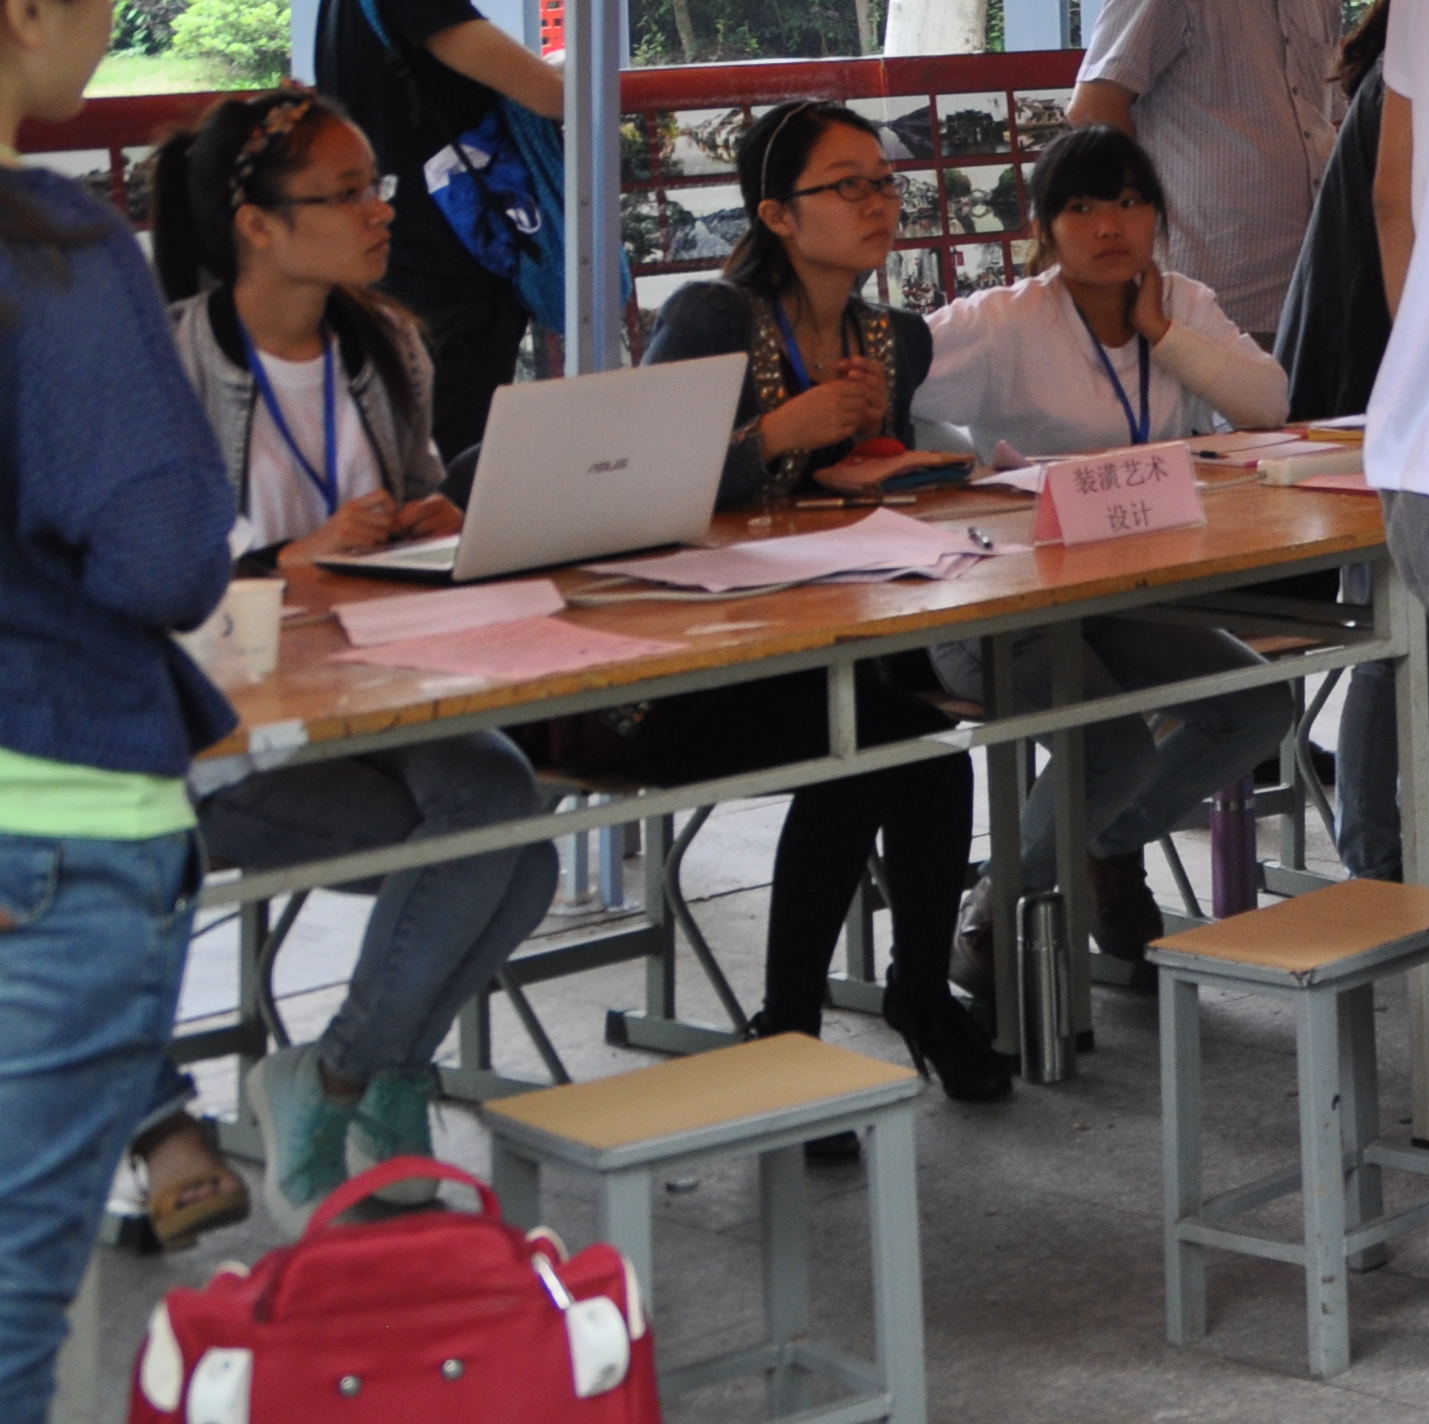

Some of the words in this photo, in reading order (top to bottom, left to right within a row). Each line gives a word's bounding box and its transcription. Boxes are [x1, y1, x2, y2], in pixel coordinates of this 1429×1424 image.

[1072, 457, 1168, 494] 装潢艺术
[1105, 502, 1152, 533] 设计
